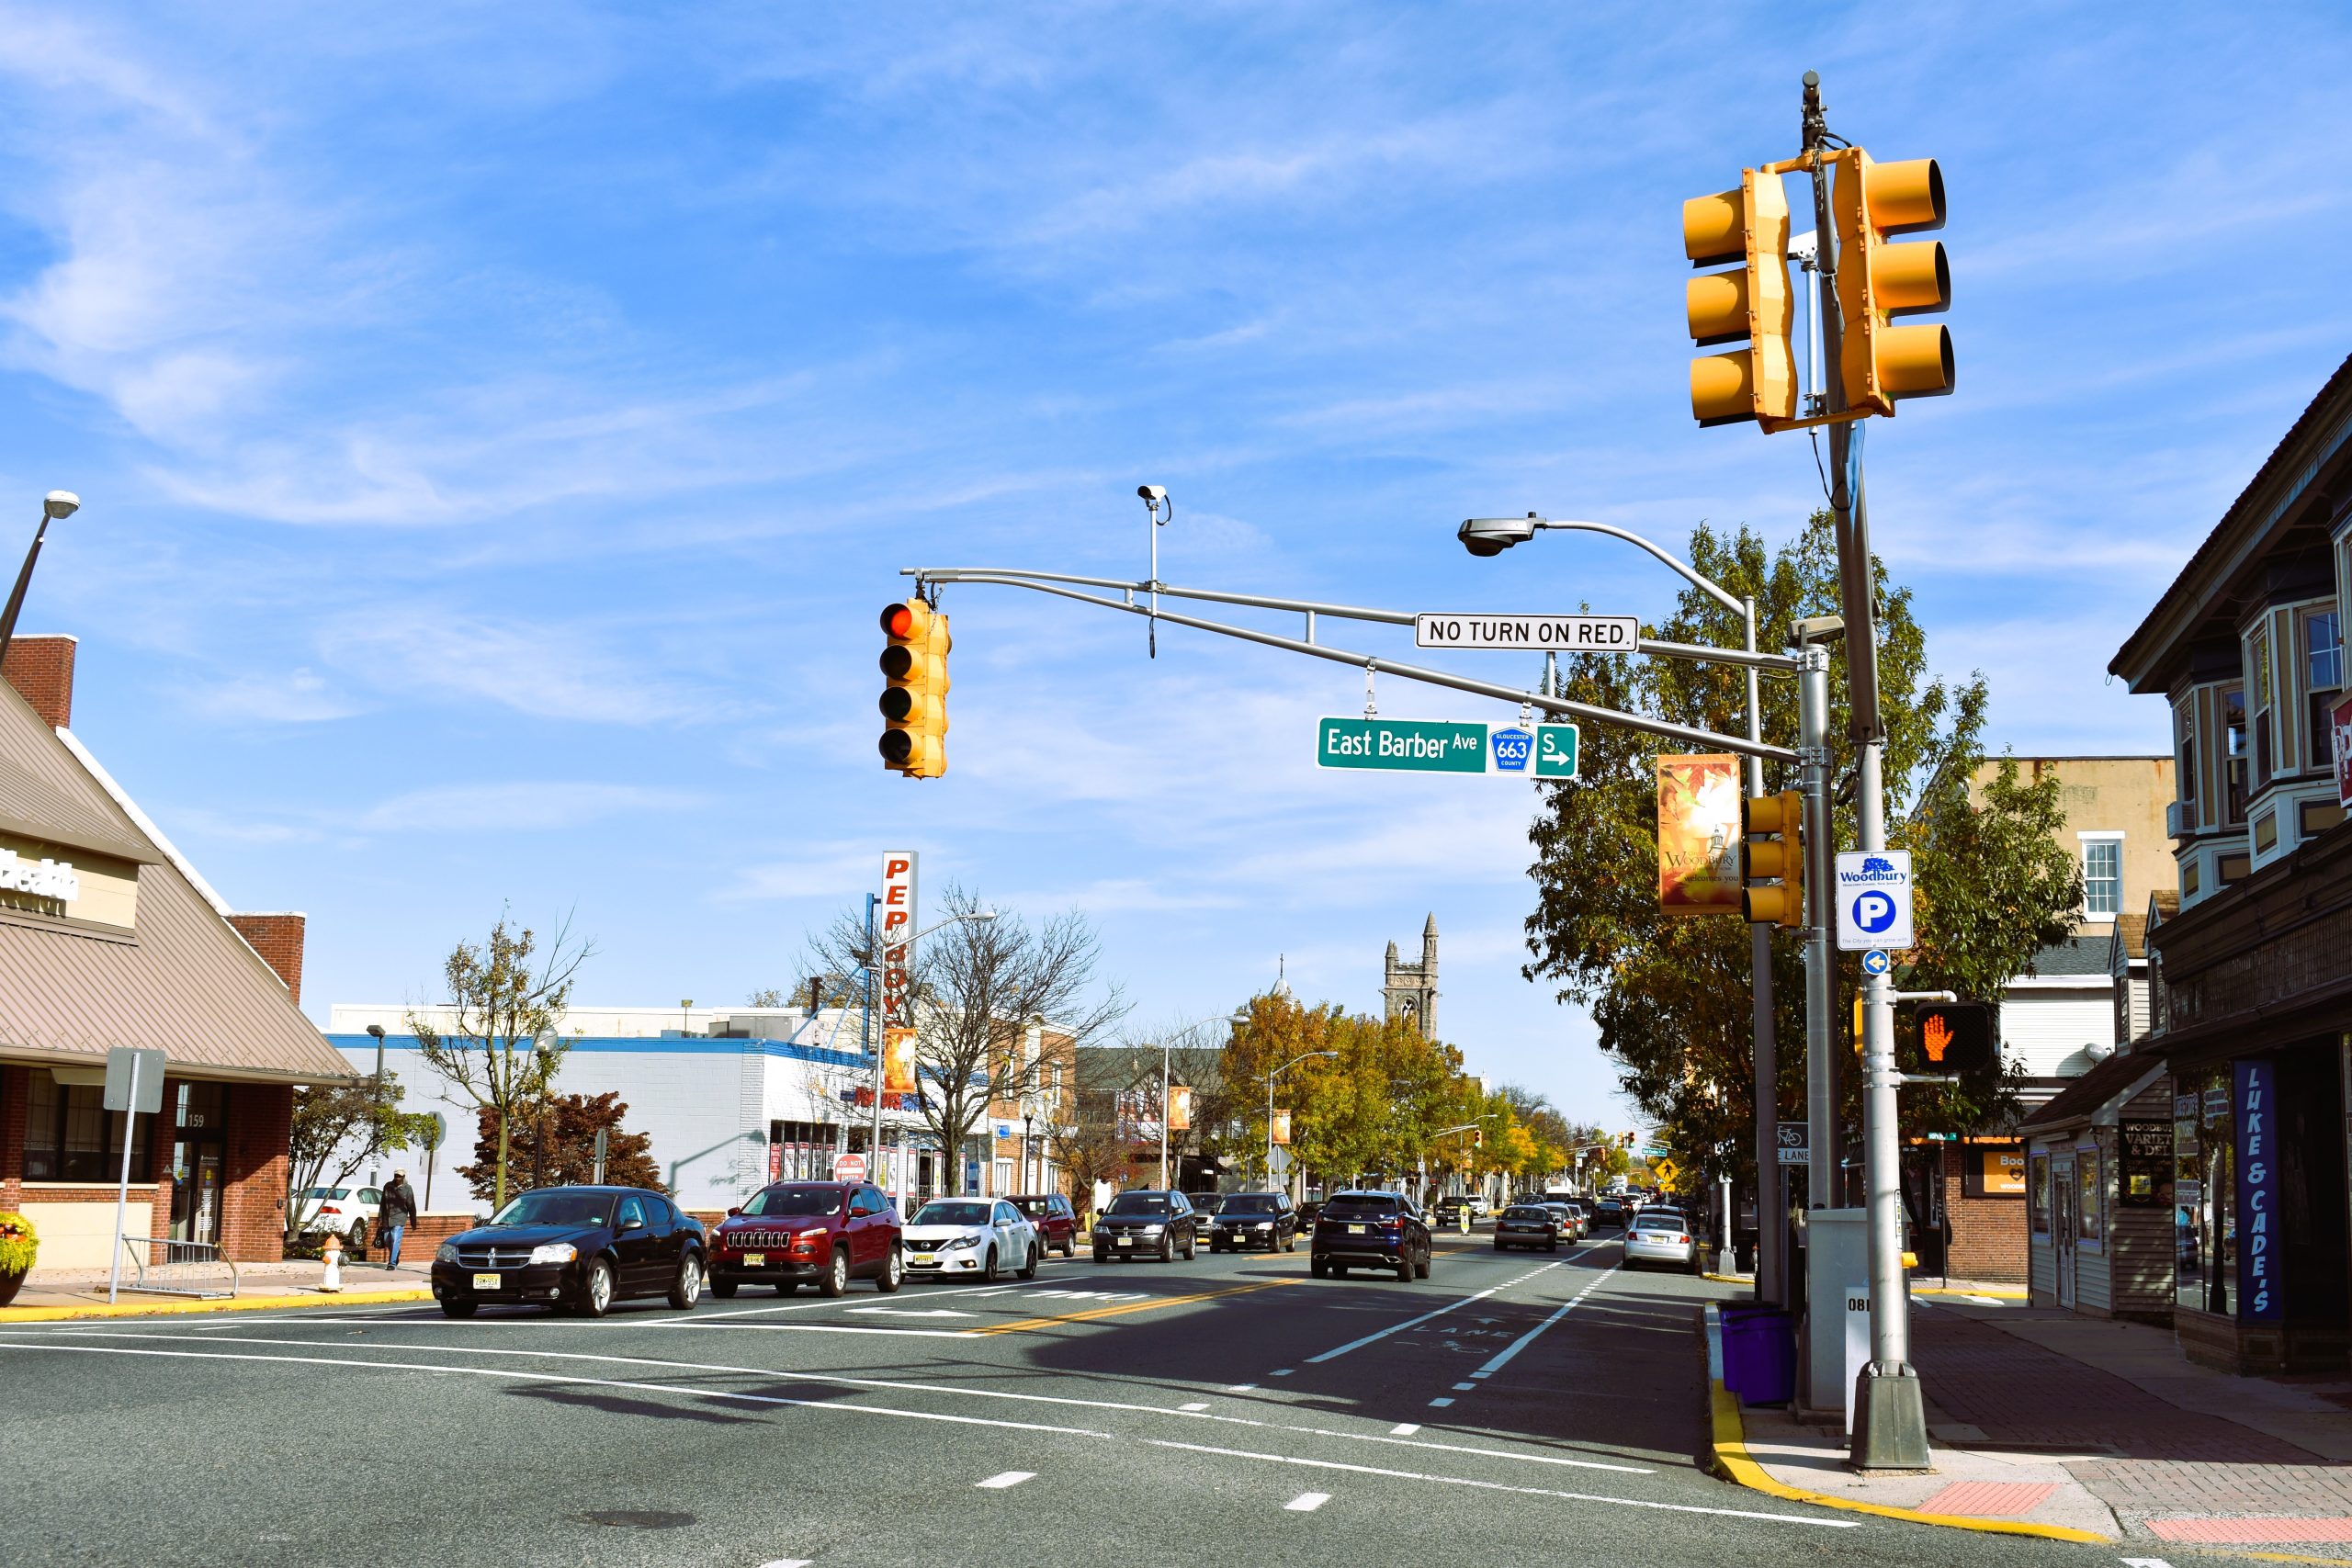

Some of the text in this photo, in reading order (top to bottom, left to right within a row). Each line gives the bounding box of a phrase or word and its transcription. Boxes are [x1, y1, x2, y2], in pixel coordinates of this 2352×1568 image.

[1430, 620, 1624, 645] NO TURN ON RED
[1327, 728, 1477, 760] East Barber Ave
[1497, 741, 1528, 759] 663
[1543, 733, 1555, 754] S
[1684, 873, 1739, 885] welcomes you
[1839, 871, 1907, 885] Woodbury
[885, 859, 910, 931] PEP
[1860, 897, 1889, 928] P
[188, 1113, 205, 1128] 159
[1784, 1150, 1809, 1161] LANE
[2131, 1145, 2141, 1156] &
[2245, 1067, 2268, 1313] LUKE & CADE'S
